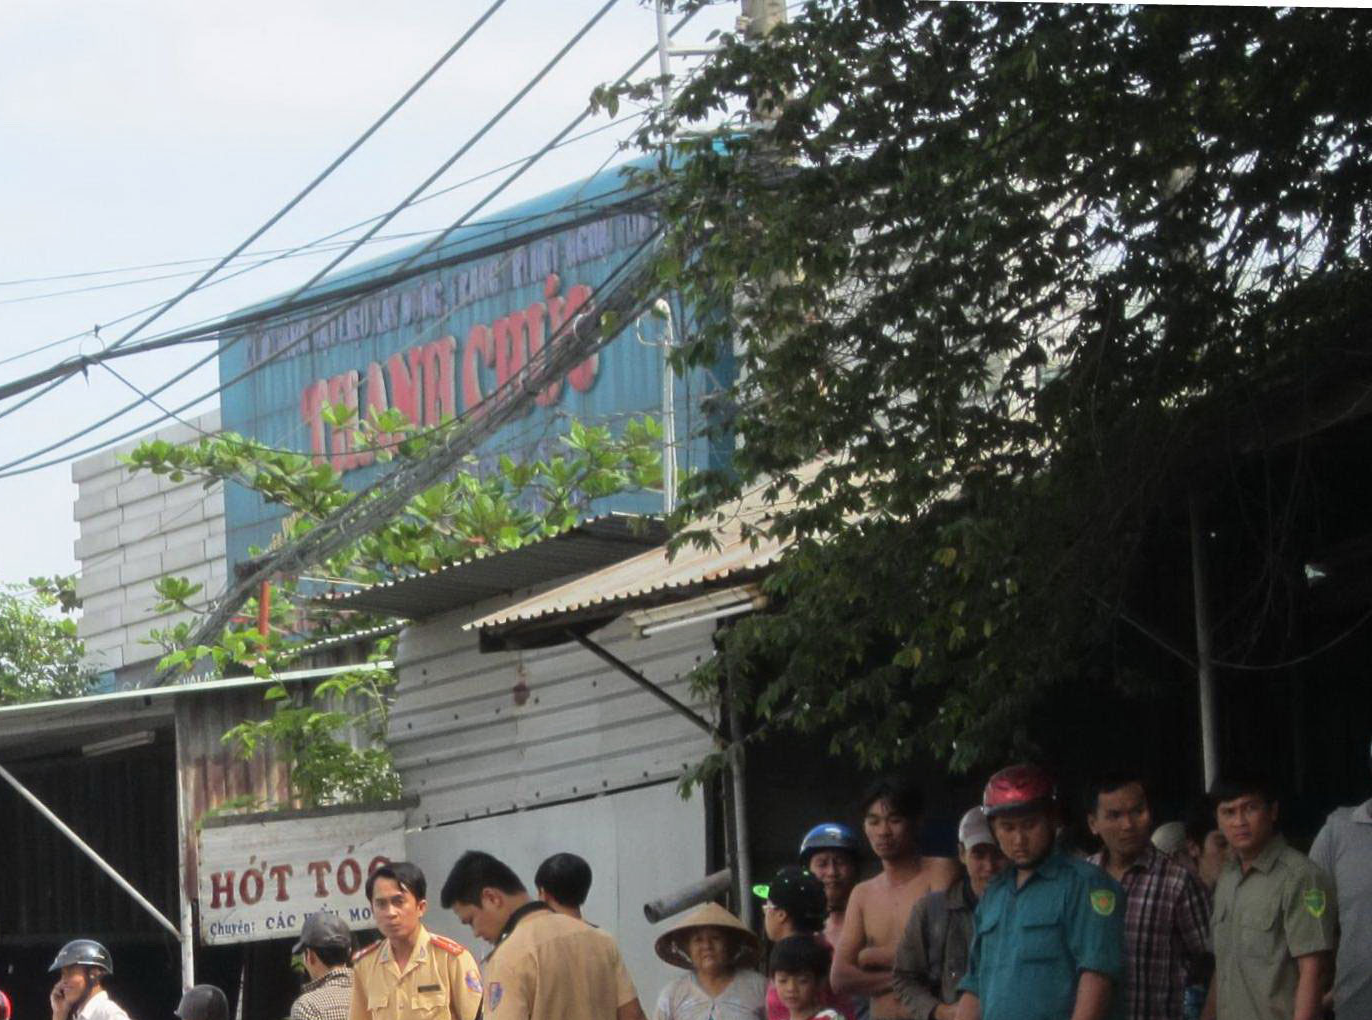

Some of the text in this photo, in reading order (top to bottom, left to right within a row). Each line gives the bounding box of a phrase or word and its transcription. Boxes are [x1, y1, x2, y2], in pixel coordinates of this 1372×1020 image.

[301, 334, 457, 475] THANH
[210, 855, 294, 909] HỚT
[266, 911, 297, 930] CÁC
